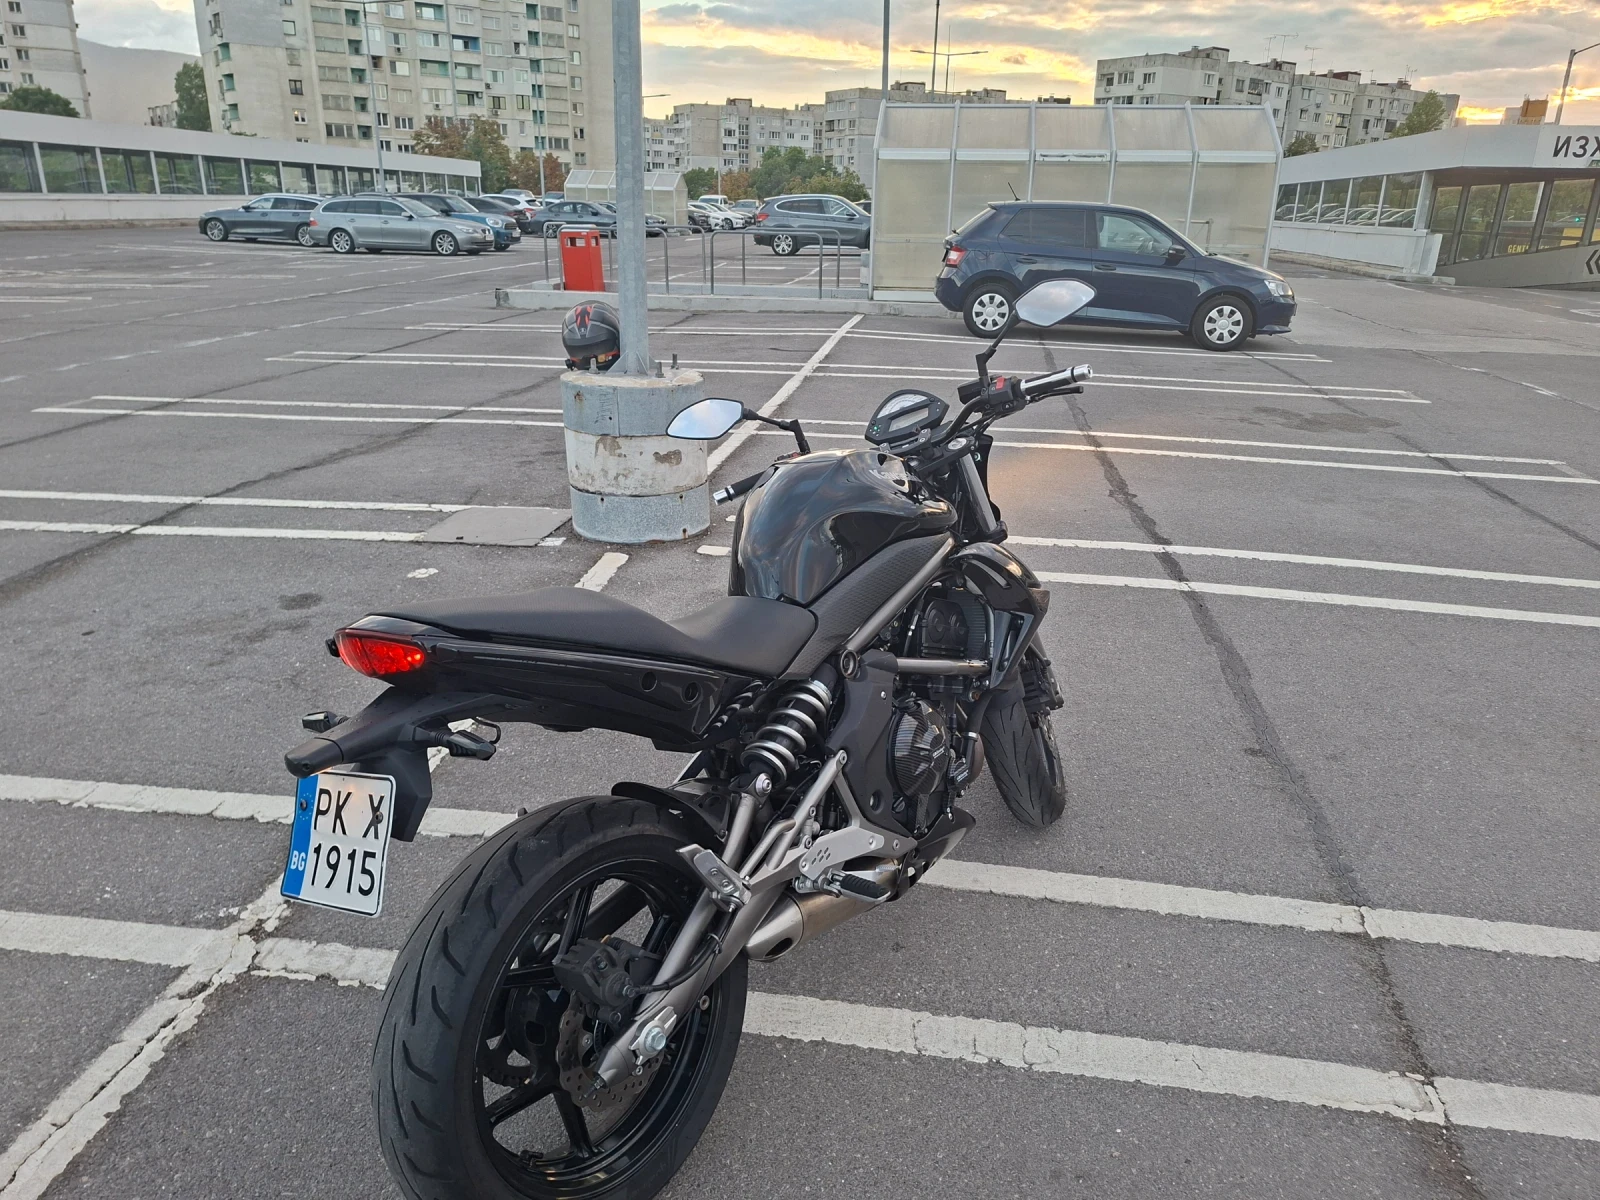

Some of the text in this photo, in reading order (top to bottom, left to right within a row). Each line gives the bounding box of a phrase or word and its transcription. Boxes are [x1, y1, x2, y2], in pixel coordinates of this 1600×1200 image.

[314, 788, 385, 840] PK X
[291, 850, 306, 871] BG
[311, 843, 377, 897] 1915
